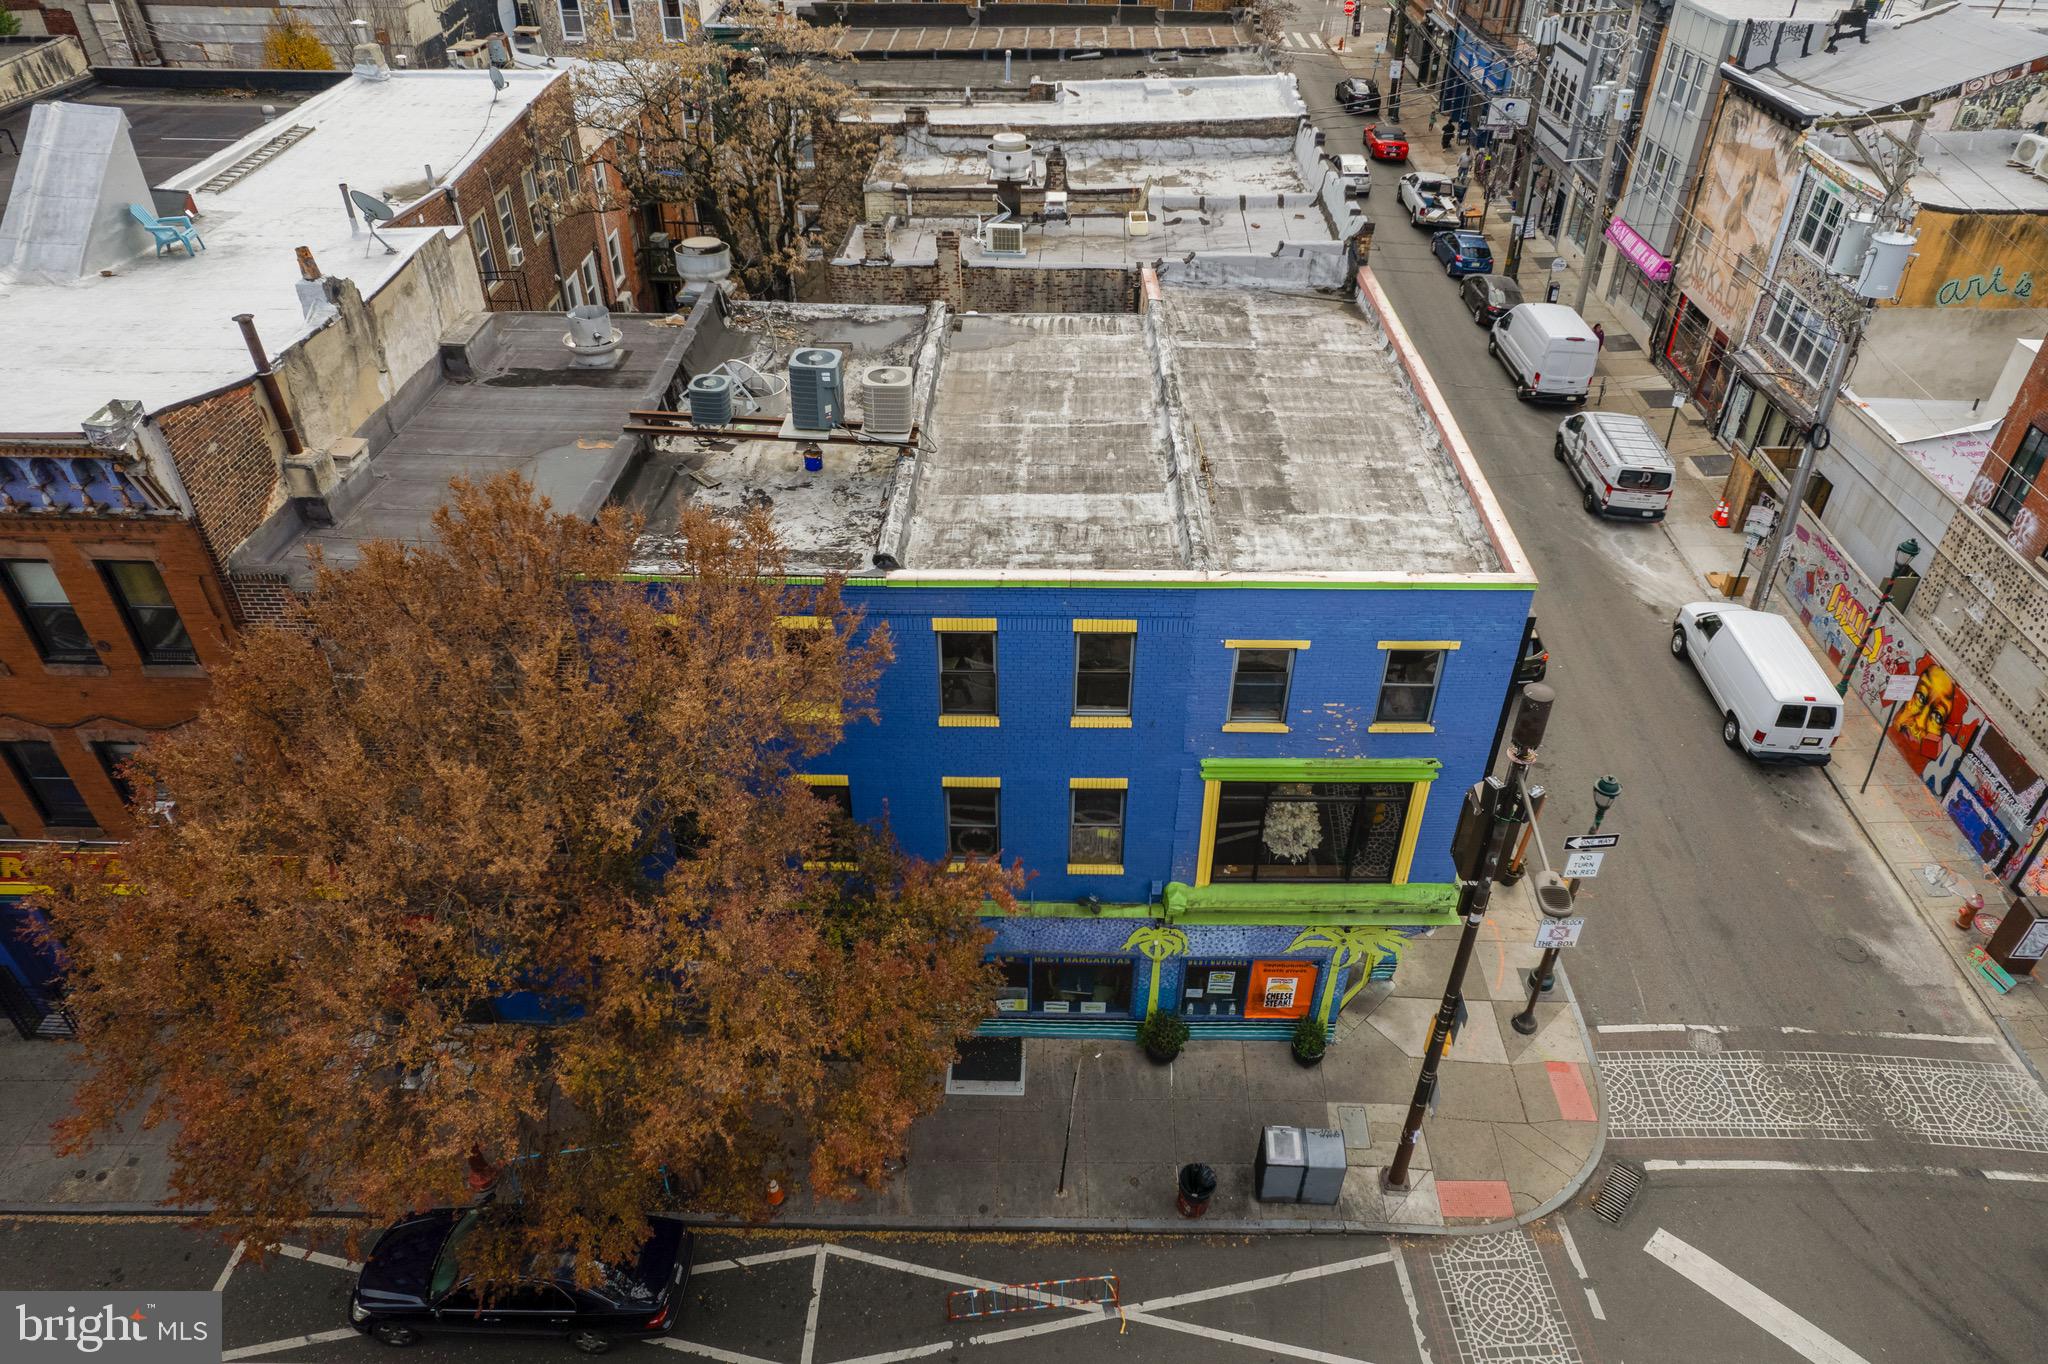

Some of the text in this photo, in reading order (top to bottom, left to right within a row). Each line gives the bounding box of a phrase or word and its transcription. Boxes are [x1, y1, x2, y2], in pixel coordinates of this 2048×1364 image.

[1938, 266, 2008, 305] art
[1826, 583, 1893, 665] PHILLY
[1265, 999, 1291, 1007] STEAK!
[1266, 992, 1293, 1000] CHEESE
